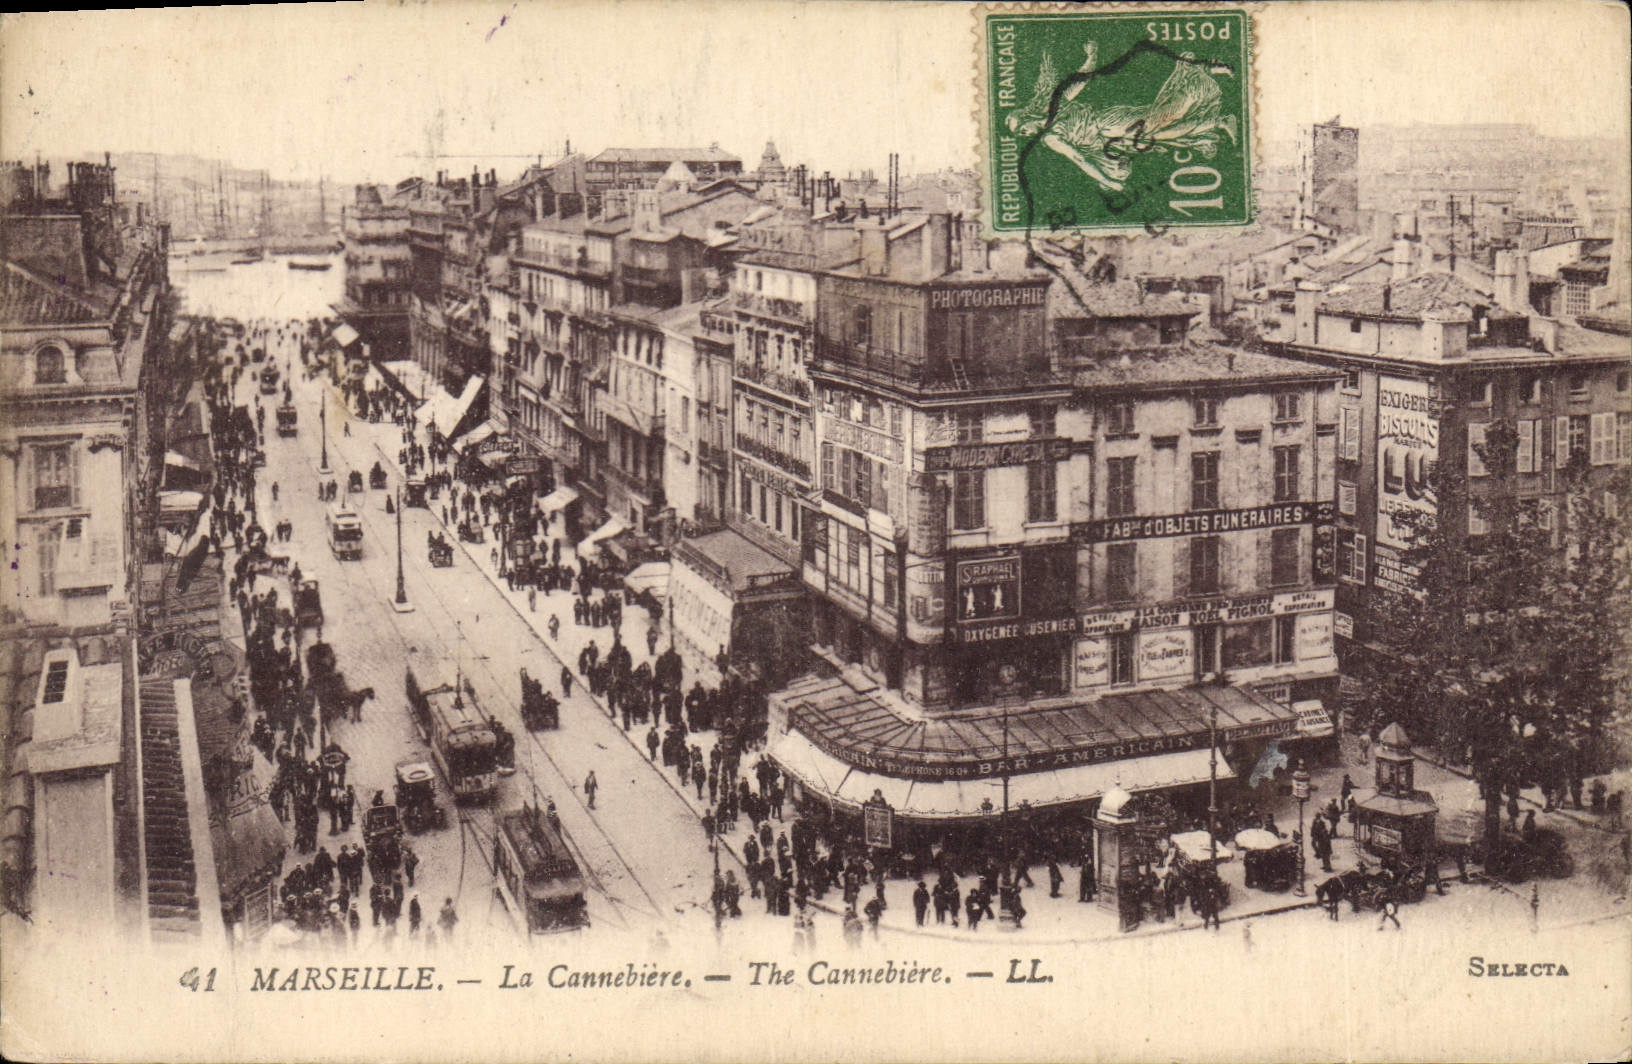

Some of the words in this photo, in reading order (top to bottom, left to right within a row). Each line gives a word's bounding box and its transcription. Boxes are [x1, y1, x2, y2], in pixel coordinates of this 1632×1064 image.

[1147, 21, 1231, 41] POSTES
[931, 287, 1045, 309] PHOTOGRAPHIE
[1379, 414, 1438, 449] BISCUITS
[1227, 603, 1276, 620] PIGNOL
[979, 757, 1028, 775] BAR
[1053, 735, 1194, 765] AMERICAIN
